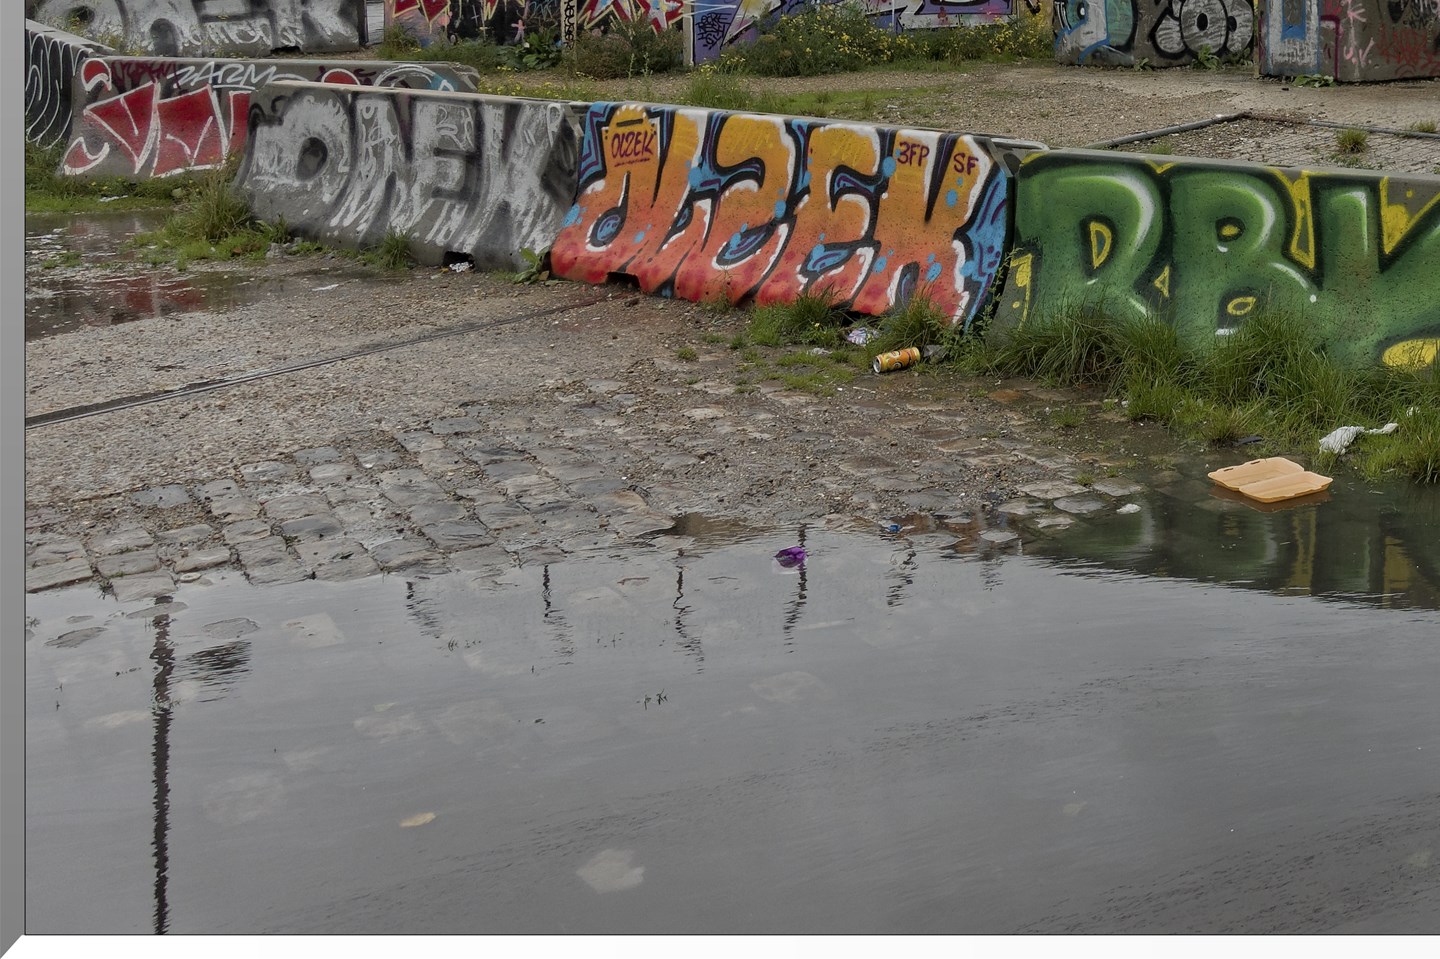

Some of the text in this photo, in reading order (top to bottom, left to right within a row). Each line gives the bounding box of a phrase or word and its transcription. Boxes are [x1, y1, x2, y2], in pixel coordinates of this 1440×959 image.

[243, 85, 574, 269] ONEK
[896, 140, 979, 174] 3FP SF
